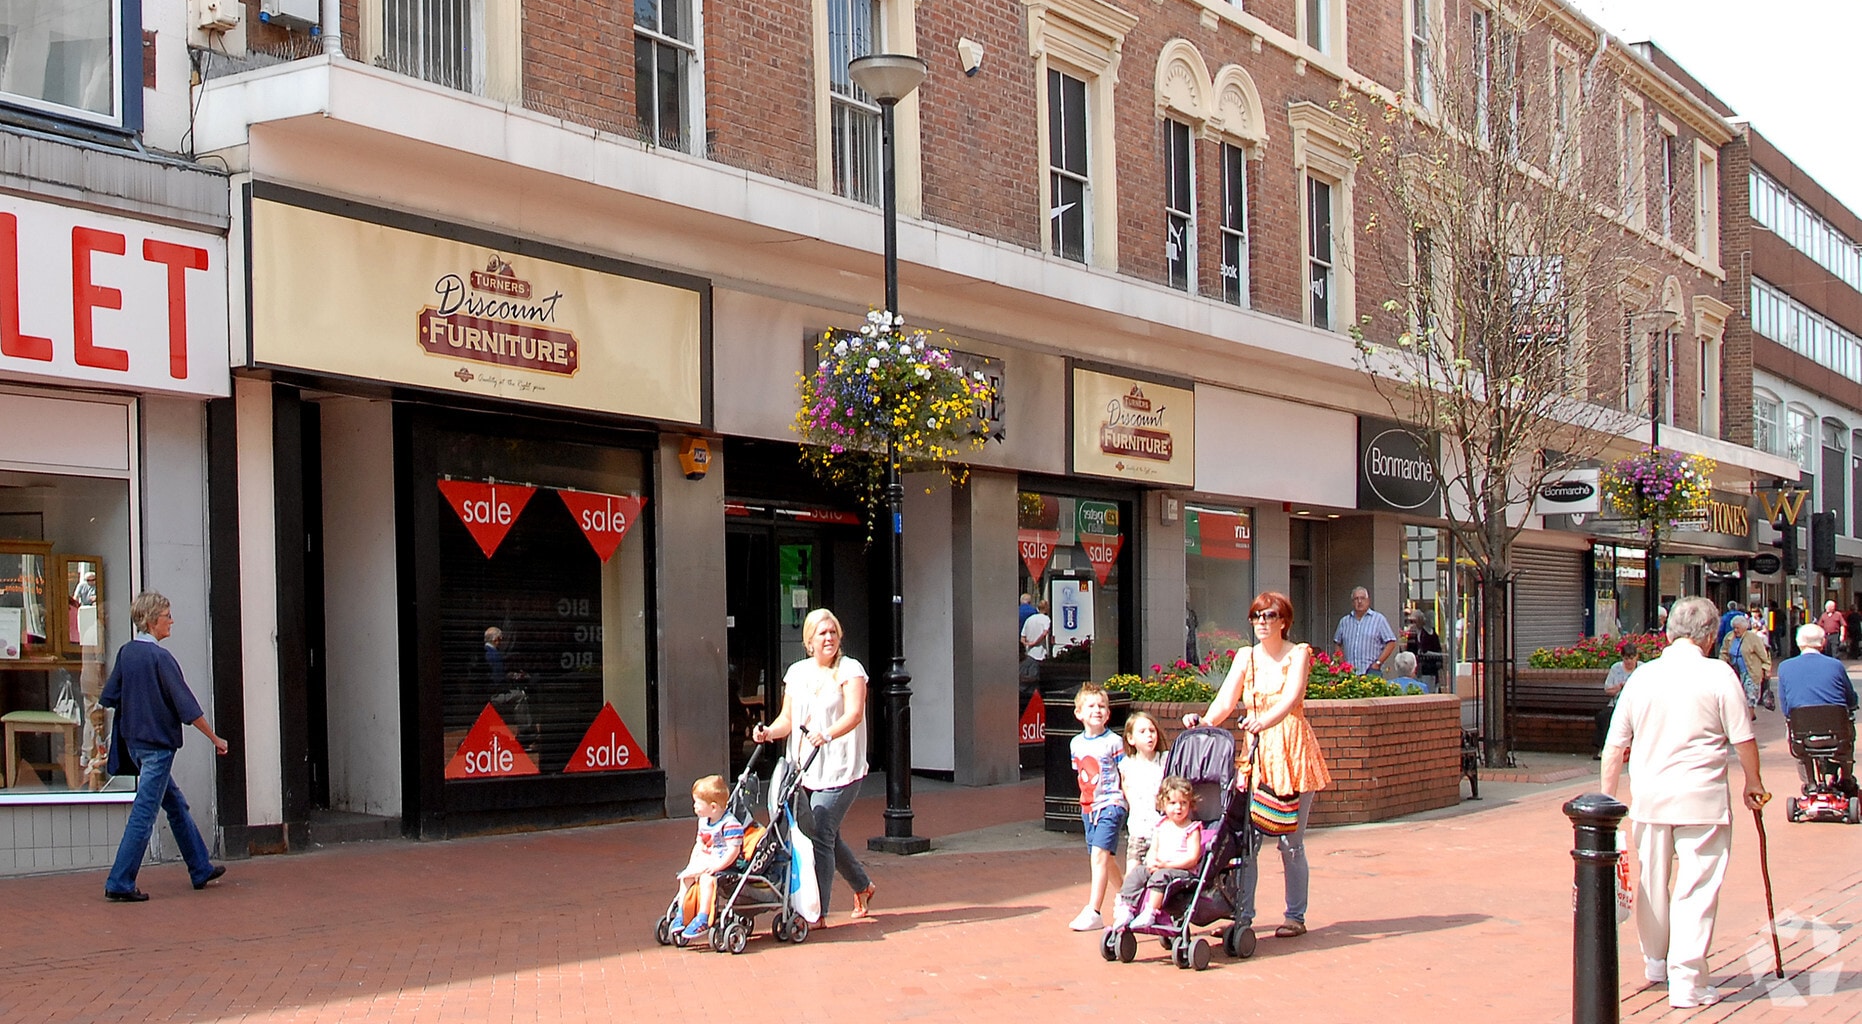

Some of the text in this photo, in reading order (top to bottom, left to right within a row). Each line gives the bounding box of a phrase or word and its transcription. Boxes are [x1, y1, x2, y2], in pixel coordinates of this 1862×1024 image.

[435, 274, 563, 323] Discount
[475, 273, 525, 294] TURNERS
[429, 316, 568, 366] FURNITURE
[1107, 399, 1166, 428] Discount
[1125, 397, 1149, 409] TURNERS
[1104, 428, 1168, 455] FURNITURE
[463, 487, 512, 525] sale
[582, 497, 626, 533] sale
[1756, 489, 1810, 526] W
[1022, 532, 1048, 559] sale
[1089, 537, 1113, 563] sale
[1022, 712, 1046, 740] sale
[465, 736, 514, 774] sale
[586, 732, 629, 767] sale
